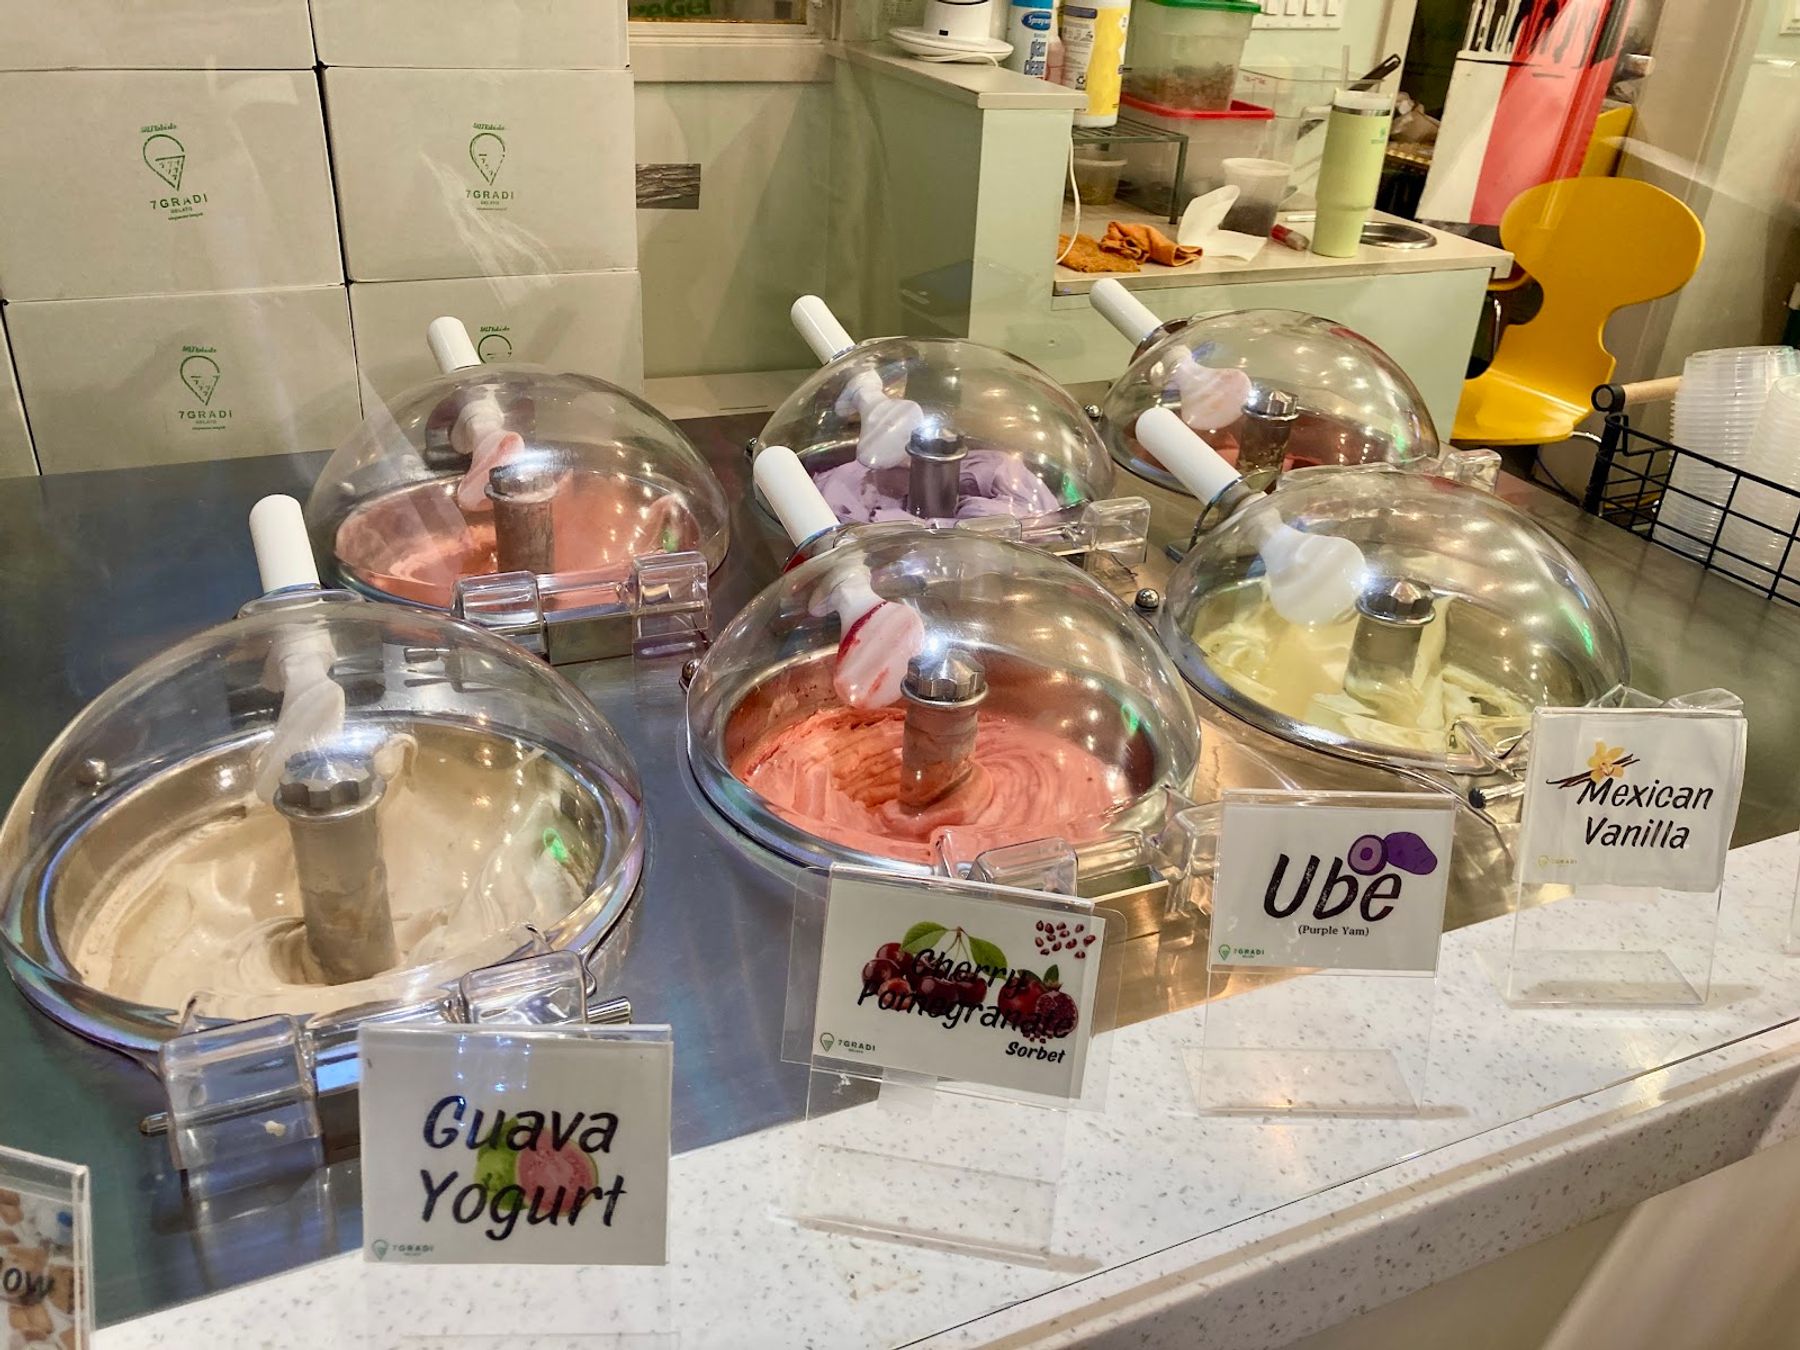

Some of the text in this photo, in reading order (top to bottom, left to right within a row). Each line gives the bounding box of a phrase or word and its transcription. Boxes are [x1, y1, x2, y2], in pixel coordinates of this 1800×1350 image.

[150, 193, 208, 210] 7GRADI
[465, 189, 514, 200] 7GRADI
[178, 409, 232, 419] 7GRADI
[1576, 777, 1714, 811] Mexican
[1585, 816, 1690, 850] Vanilla
[1263, 853, 1403, 922] Ube
[1298, 925, 1370, 937] (Purple Yam)
[911, 948, 1028, 997] Cherry
[838, 1039, 876, 1051] 7GRADI
[1005, 1041, 1066, 1064] Sorbet
[422, 1095, 620, 1154] Guava
[419, 1169, 628, 1241] Yogurt
[0, 1257, 55, 1302] ow
